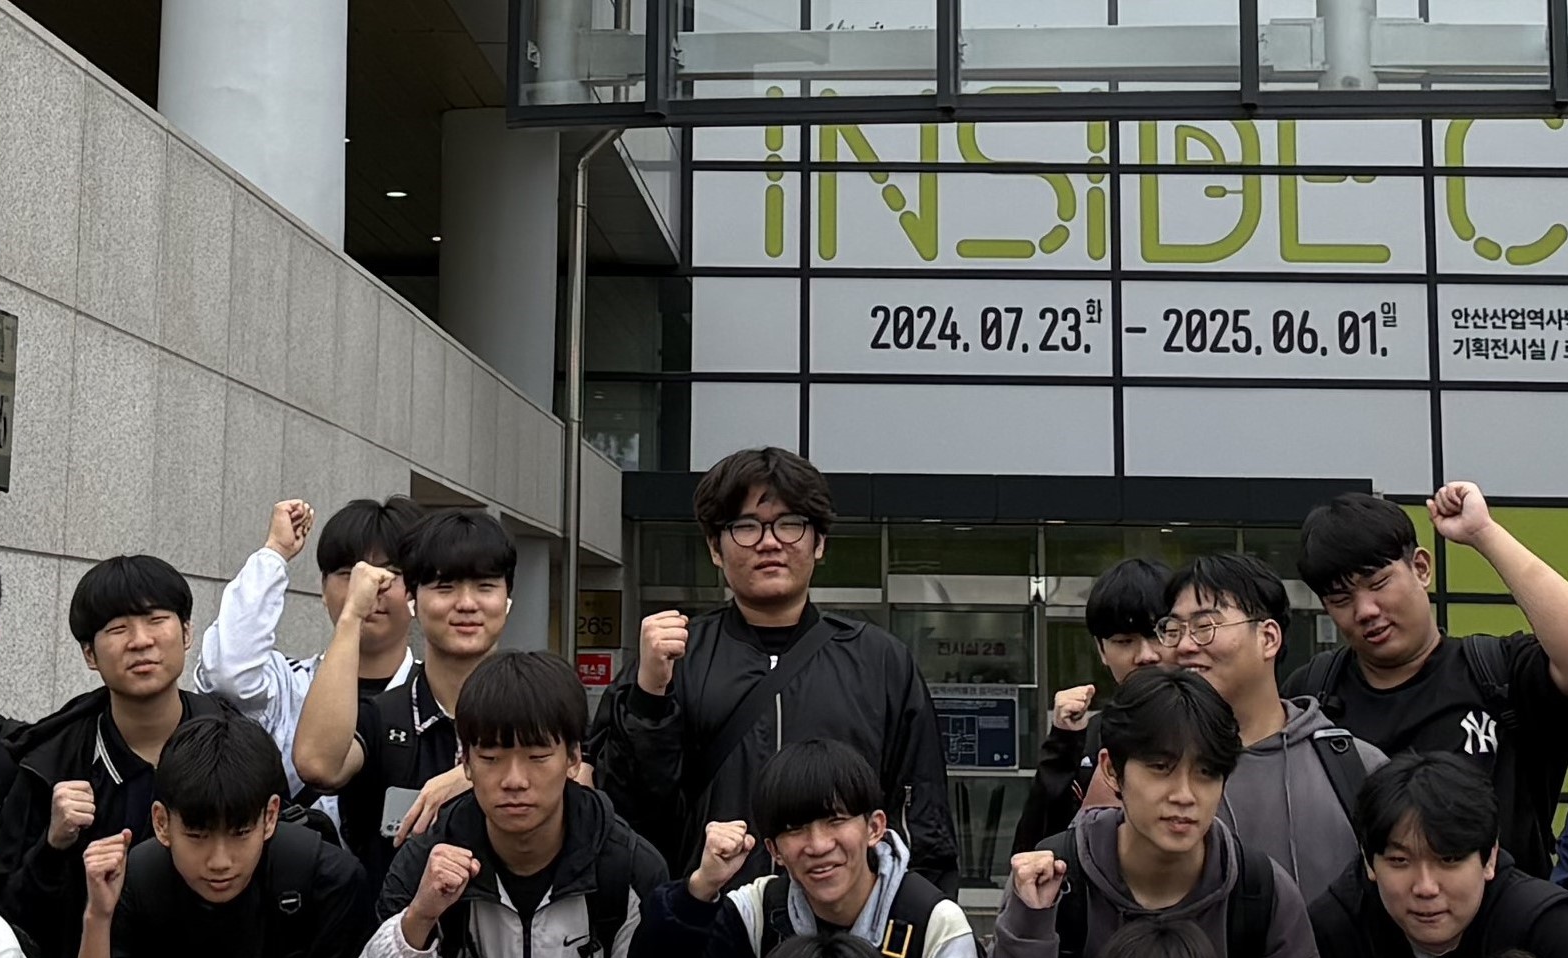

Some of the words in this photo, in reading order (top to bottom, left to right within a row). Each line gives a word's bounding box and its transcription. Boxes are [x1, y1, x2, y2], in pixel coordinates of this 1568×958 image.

[870, 305, 970, 352] 2024.
[980, 306, 1029, 353] 07.
[1162, 308, 1262, 355] 2025.
[1272, 309, 1328, 356] 06.
[1453, 337, 1546, 360] 기획전시실
[1460, 710, 1499, 755] NY
